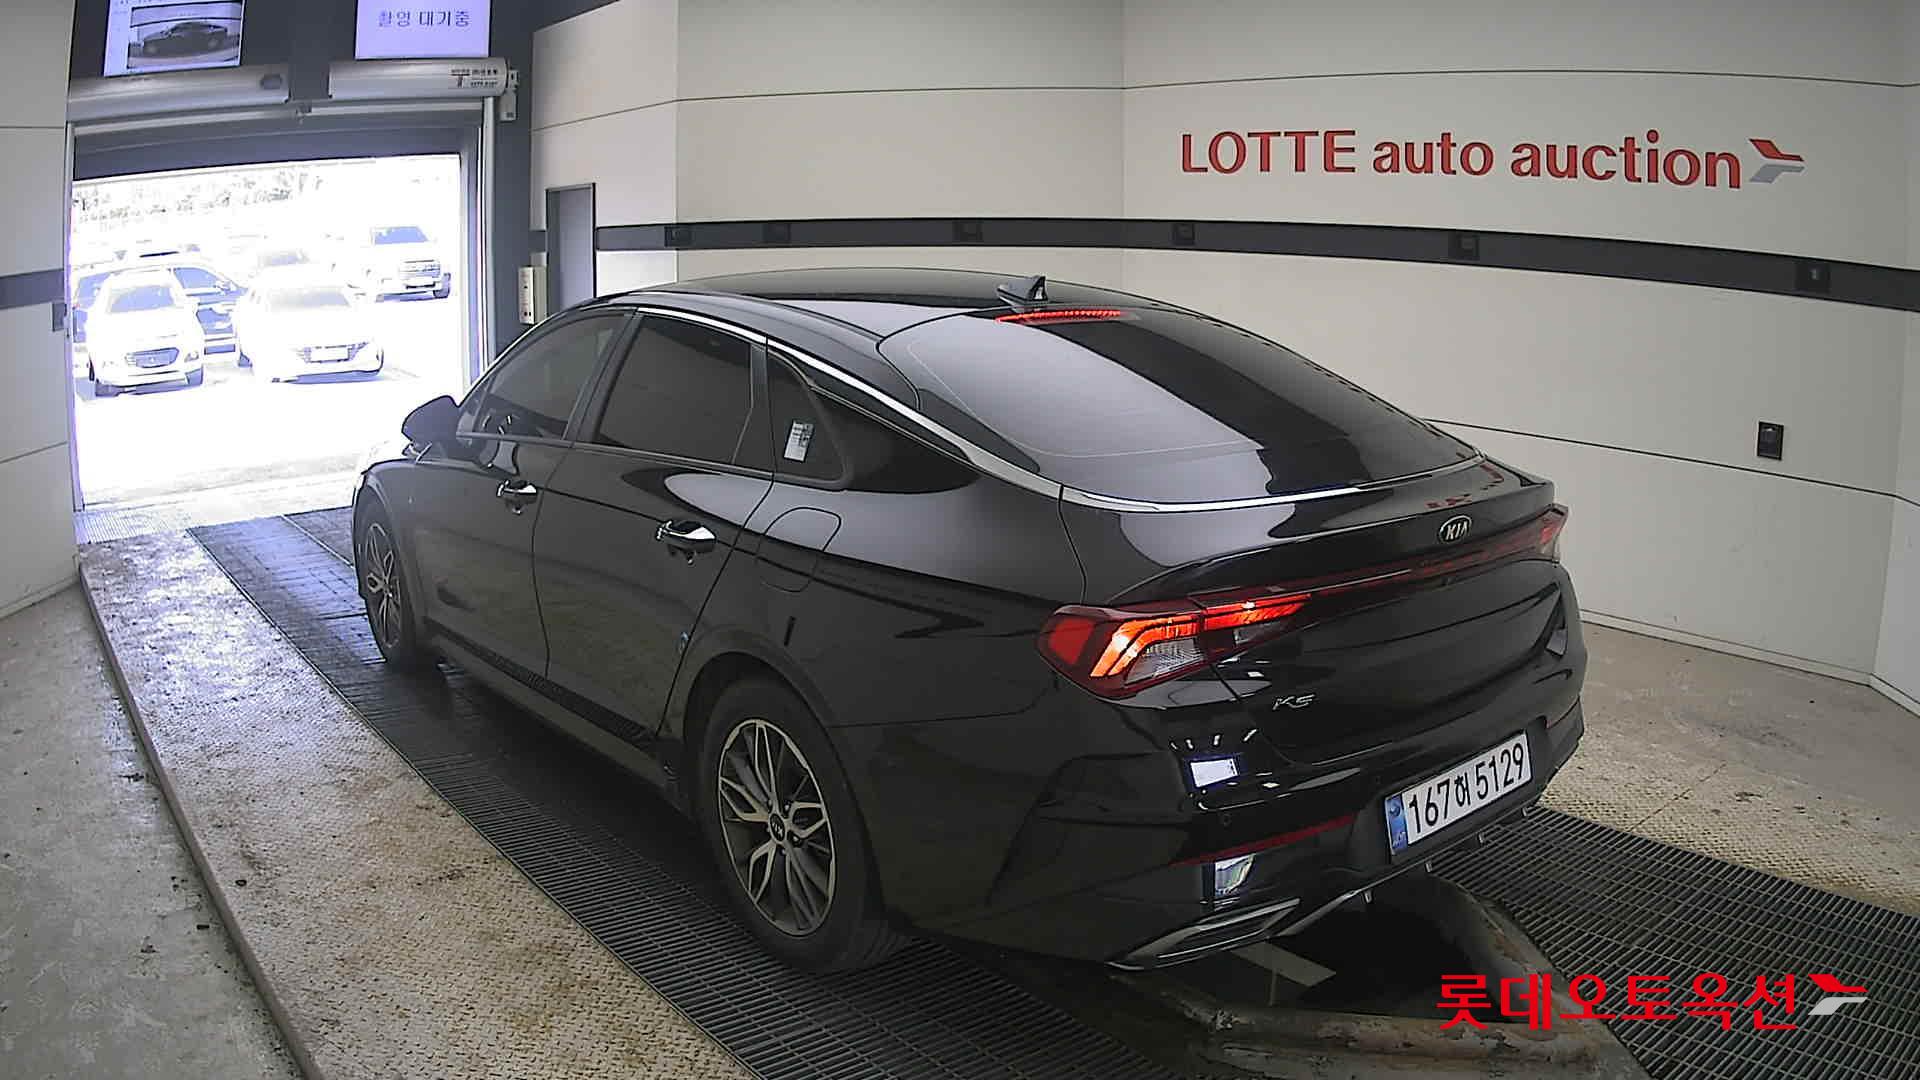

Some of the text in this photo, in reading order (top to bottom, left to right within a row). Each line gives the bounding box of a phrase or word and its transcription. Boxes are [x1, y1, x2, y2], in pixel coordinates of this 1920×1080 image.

[419, 10, 470, 28] 대기중
[1182, 129, 1742, 189] LOTTE auto auction
[1445, 520, 1469, 540] KIA
[1408, 742, 1524, 835] 167허 5129
